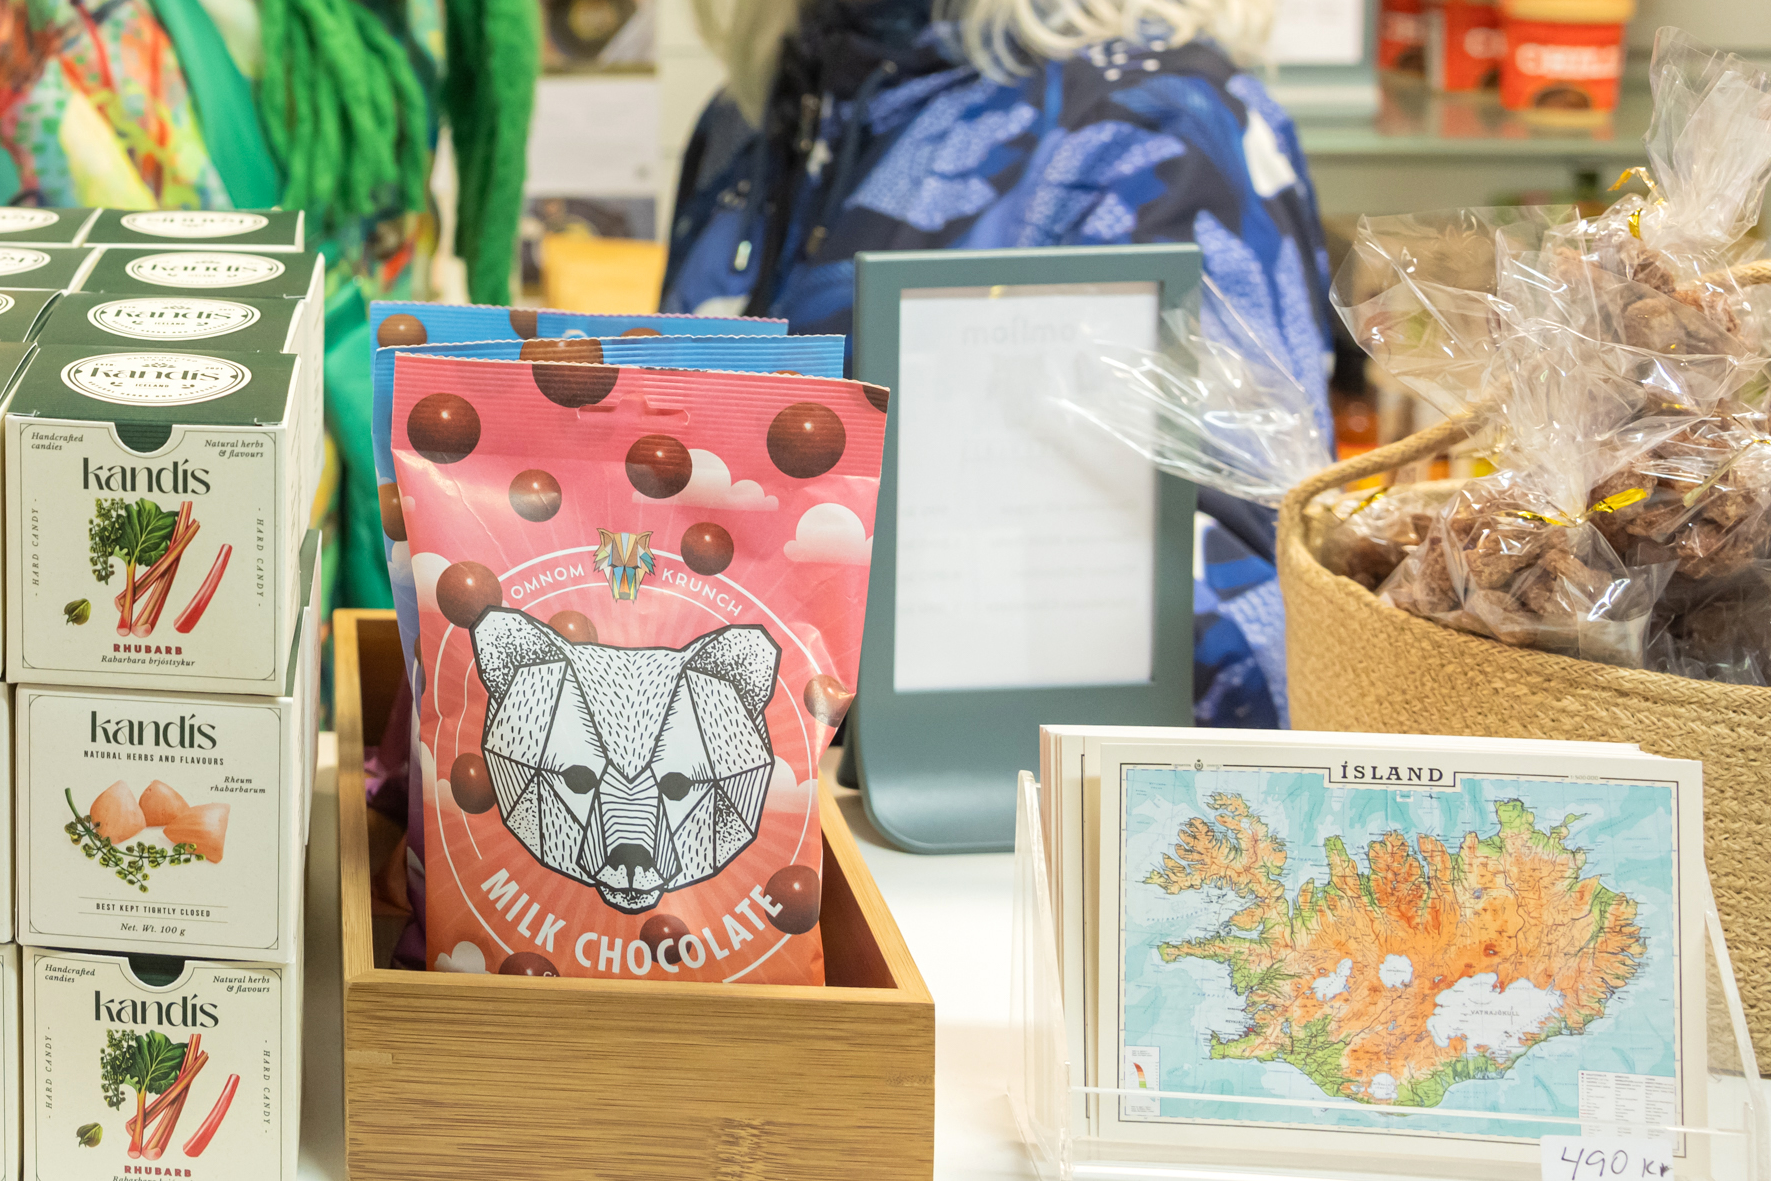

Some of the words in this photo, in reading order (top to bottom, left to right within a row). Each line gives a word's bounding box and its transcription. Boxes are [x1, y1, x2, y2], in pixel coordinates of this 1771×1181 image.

[510, 563, 585, 599] OMNOM
[662, 568, 743, 616] KRUNCH
[113, 643, 182, 655] RHUBARB
[101, 655, 146, 664] Rabarbara
[148, 657, 195, 668] brjóstsykur
[84, 750, 122, 760] NATURAL
[126, 753, 154, 762] HERBS
[159, 755, 175, 763] AND
[180, 756, 224, 766] FLAVOURS
[1340, 761, 1445, 784] ÍSLAND
[224, 776, 252, 784] Rheum
[210, 784, 266, 794] rhabarbarum
[96, 903, 115, 911] BEST
[143, 906, 176, 915] TIGHTLY
[180, 908, 210, 917] CLOSED
[480, 867, 566, 953] MILK
[574, 884, 784, 976] CHOCOLATE
[1560, 1146, 1629, 1180] 490
[124, 1165, 191, 1178] RHUBARB
